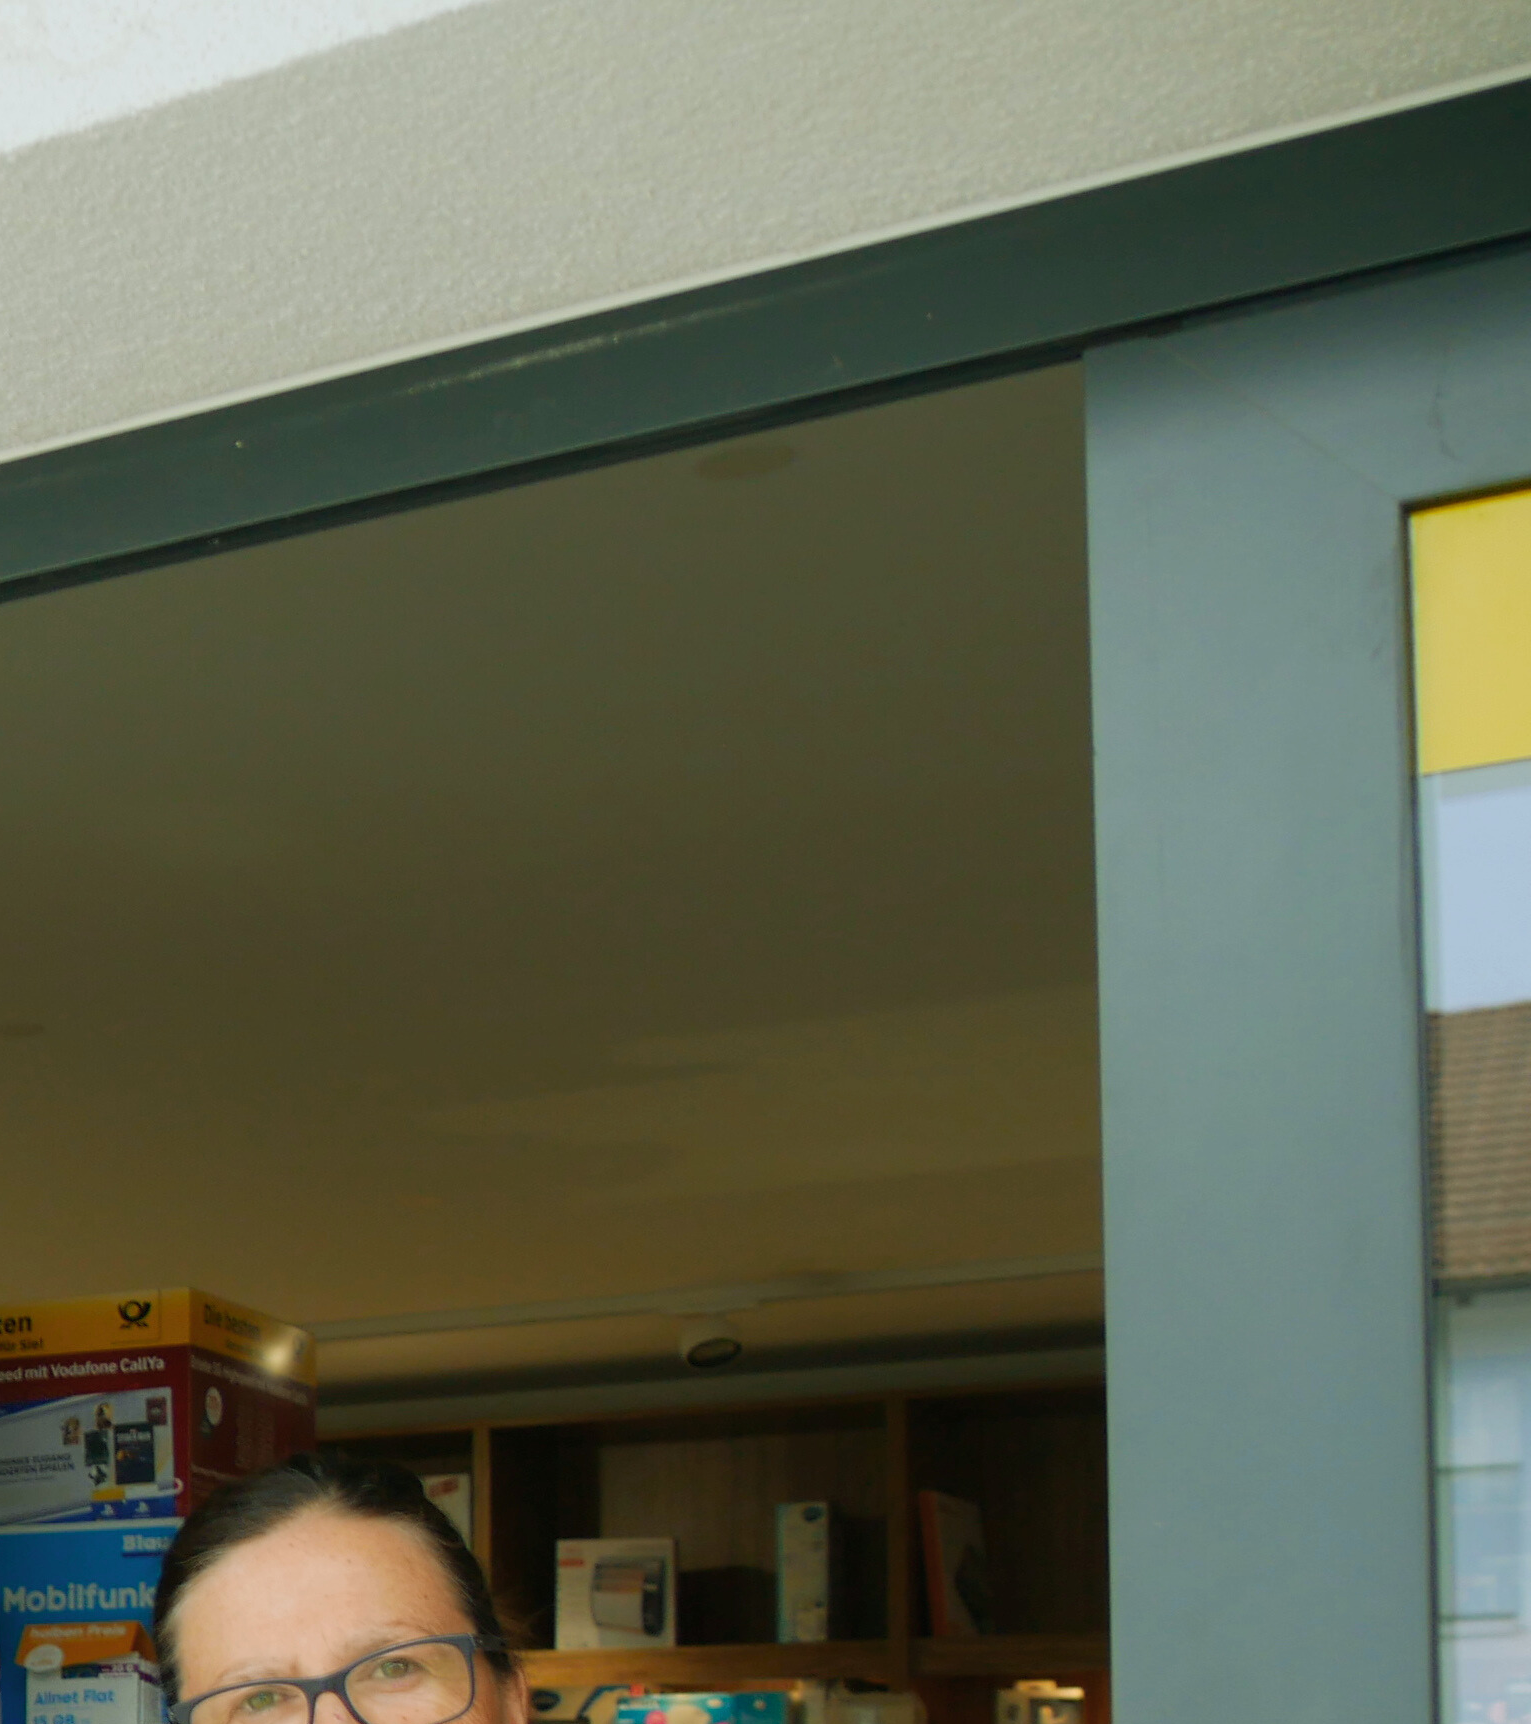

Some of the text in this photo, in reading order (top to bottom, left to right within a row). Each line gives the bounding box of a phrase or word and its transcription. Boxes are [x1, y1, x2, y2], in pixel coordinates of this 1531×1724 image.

[25, 1363, 48, 1380] mit
[51, 1360, 118, 1379] Vodafone
[120, 1355, 166, 1373] CallYa
[3, 1582, 157, 1612] Mobilfunk
[35, 1688, 116, 1705] Allnet Flat
